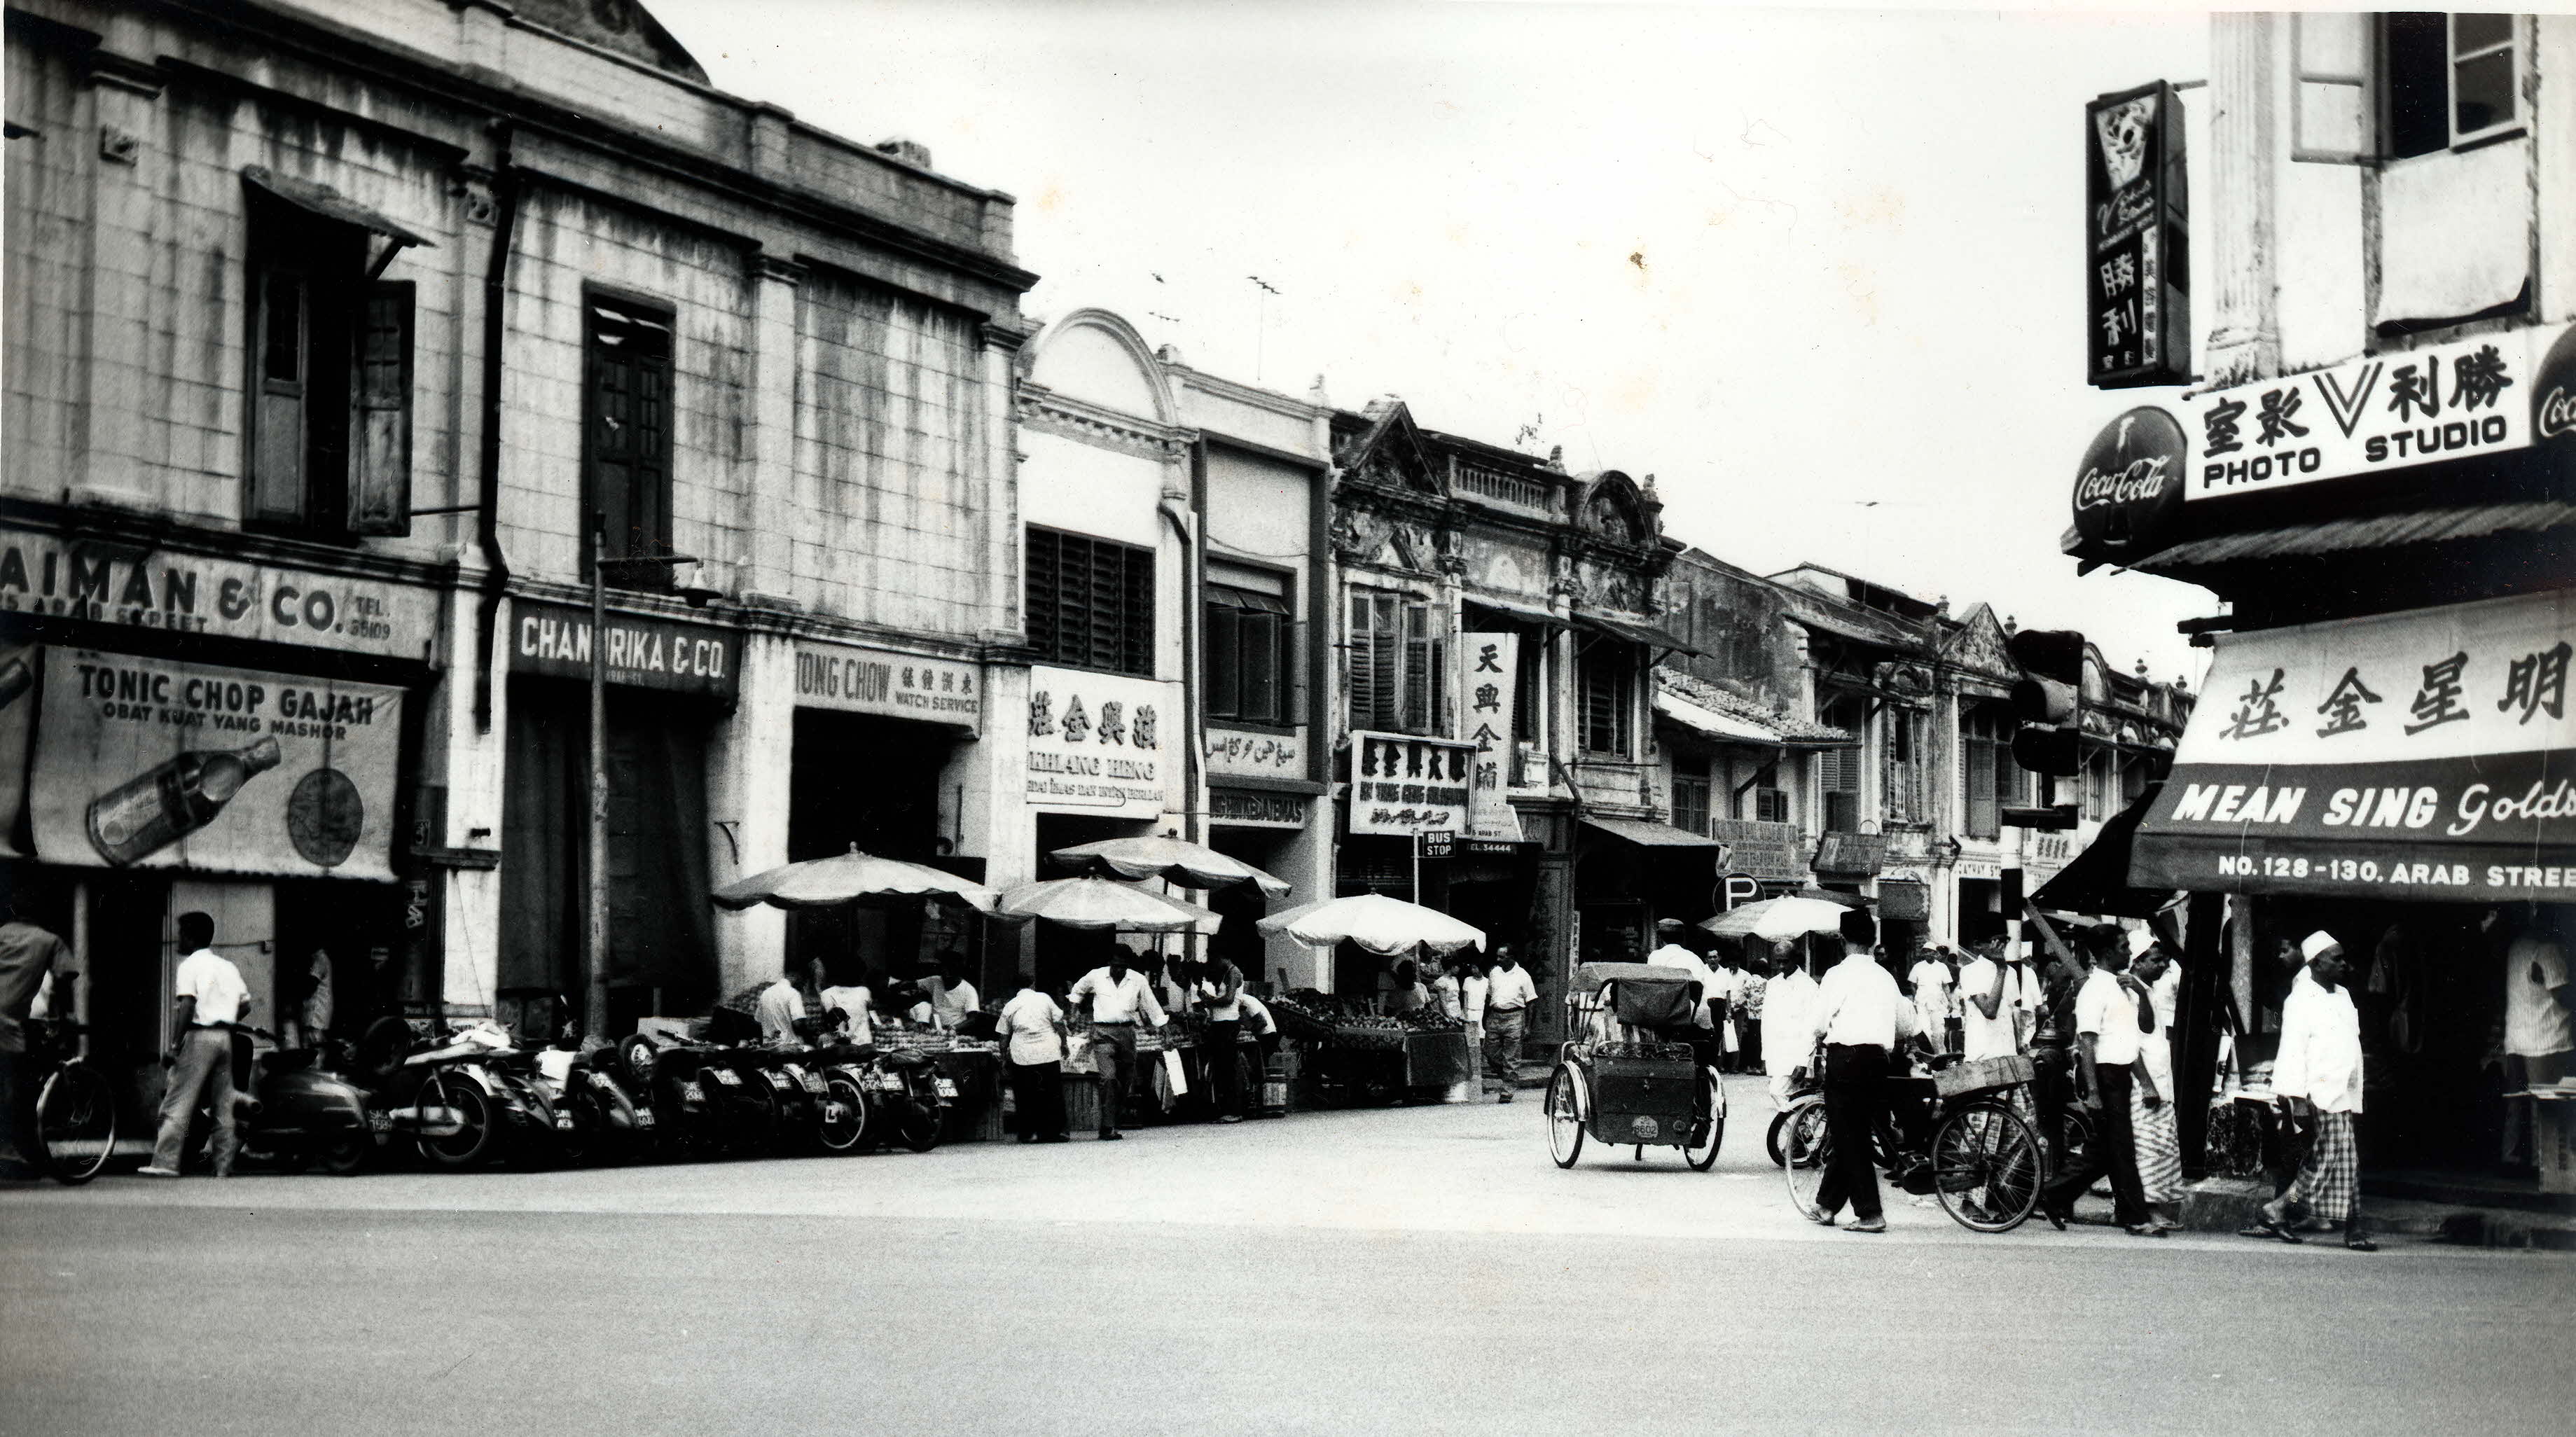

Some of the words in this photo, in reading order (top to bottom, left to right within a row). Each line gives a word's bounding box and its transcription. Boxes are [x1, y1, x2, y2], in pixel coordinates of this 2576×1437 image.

[2100, 252, 2136, 347] 勝利
[2386, 344, 2514, 424] 勝利
[2203, 387, 2310, 459] 影室
[2203, 447, 2321, 489] PHOTO
[2365, 415, 2507, 462] STUDIO
[219, 577, 251, 620] &
[272, 585, 345, 632] CO.
[521, 616, 665, 672] CHANRIKA
[672, 636, 689, 674] &
[693, 639, 726, 679] CO.
[78, 664, 170, 704] TONIC
[186, 679, 265, 714] CHOP
[280, 689, 373, 726] GAJAH
[796, 651, 840, 698] TONG
[845, 658, 892, 702] CHOW
[895, 690, 929, 710] WATCH
[932, 696, 978, 714] SERVICE
[103, 702, 153, 721] OBAT
[158, 709, 207, 728] KUAT
[213, 714, 261, 733] YANG
[270, 720, 347, 741] MASHOR
[2172, 783, 2307, 824] MEAN
[2322, 786, 2439, 828] SING
[1427, 832, 1450, 843] BUS
[1427, 845, 1452, 856] STOP
[1725, 877, 1757, 911] P
[2218, 856, 2258, 877] NO.
[2389, 863, 2470, 886] ARAB
